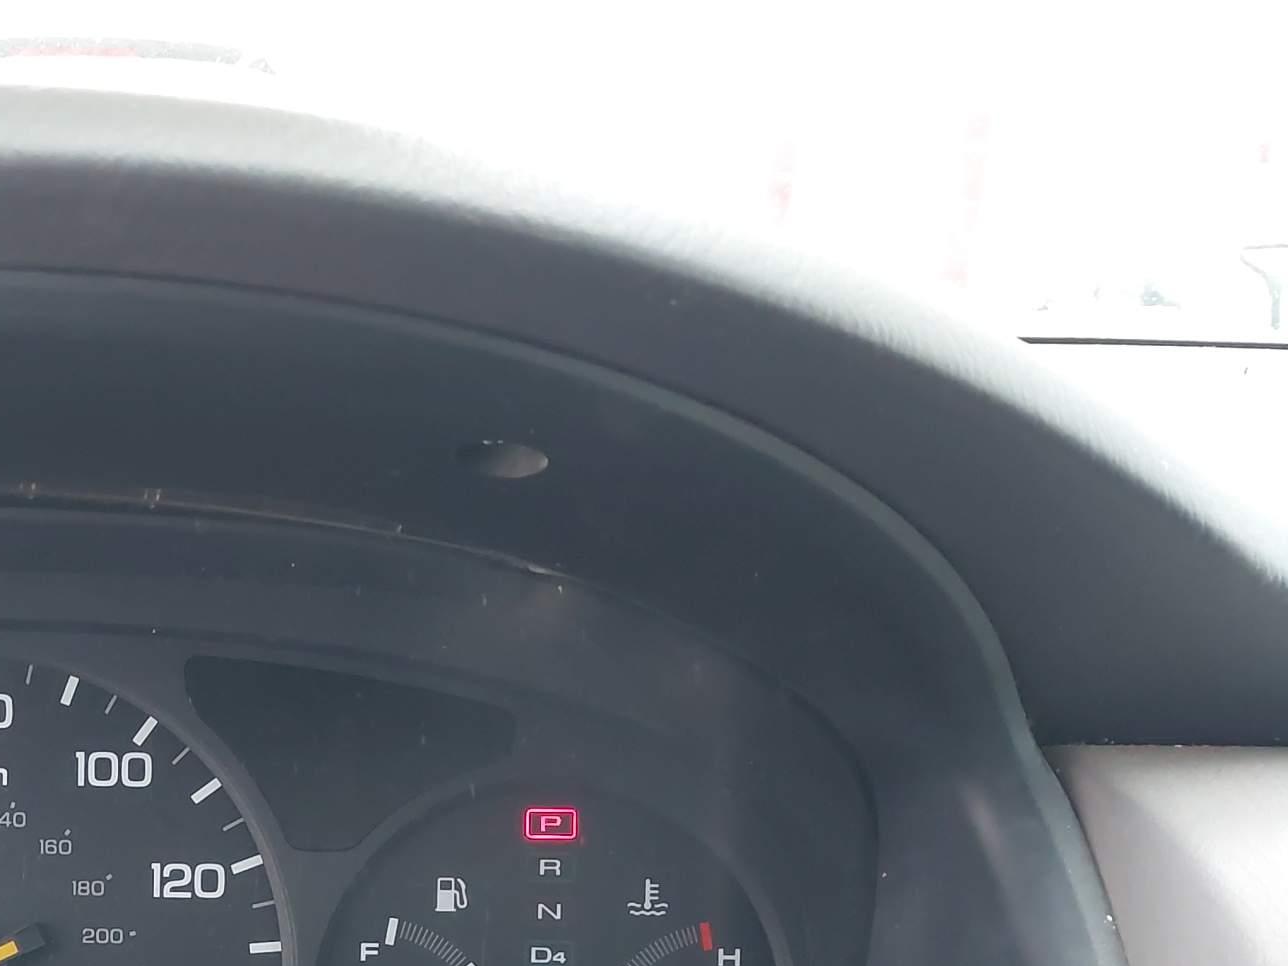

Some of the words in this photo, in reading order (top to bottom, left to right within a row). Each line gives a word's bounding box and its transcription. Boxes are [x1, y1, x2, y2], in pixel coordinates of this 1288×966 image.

[75, 751, 152, 787] 100
[540, 816, 562, 832] P
[39, 839, 72, 855] 160
[539, 859, 561, 876] R
[72, 880, 104, 896] 180
[151, 862, 225, 899] 120
[538, 904, 561, 920] N
[82, 928, 123, 944] 200
[360, 943, 379, 962] F
[530, 947, 566, 964] D4
[718, 948, 741, 966] H
